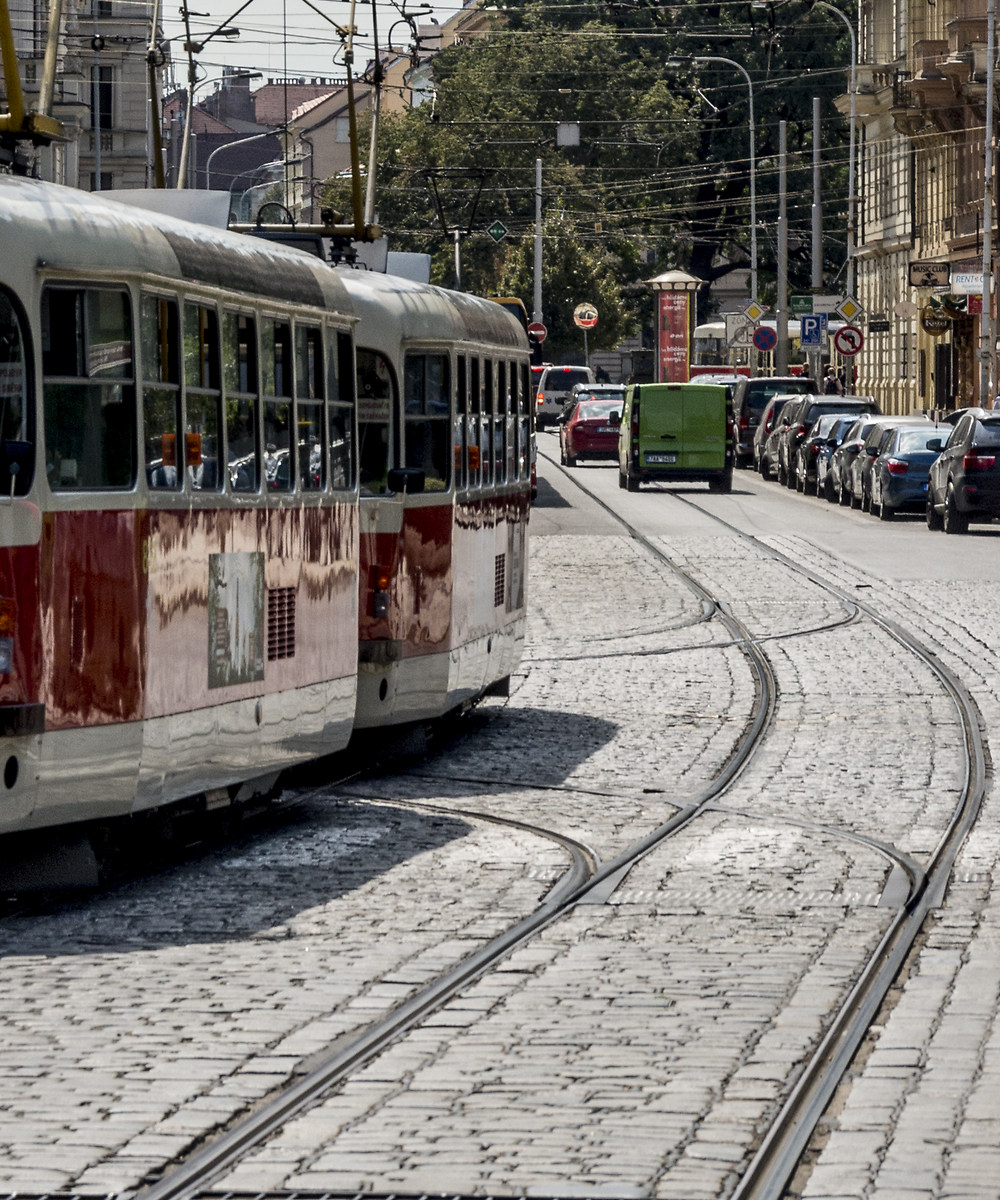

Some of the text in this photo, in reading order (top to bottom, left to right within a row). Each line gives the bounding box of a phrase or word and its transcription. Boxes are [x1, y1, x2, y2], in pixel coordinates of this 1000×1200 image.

[932, 265, 948, 273] CLUB
[955, 275, 974, 283] RENT
[804, 318, 817, 336] P
